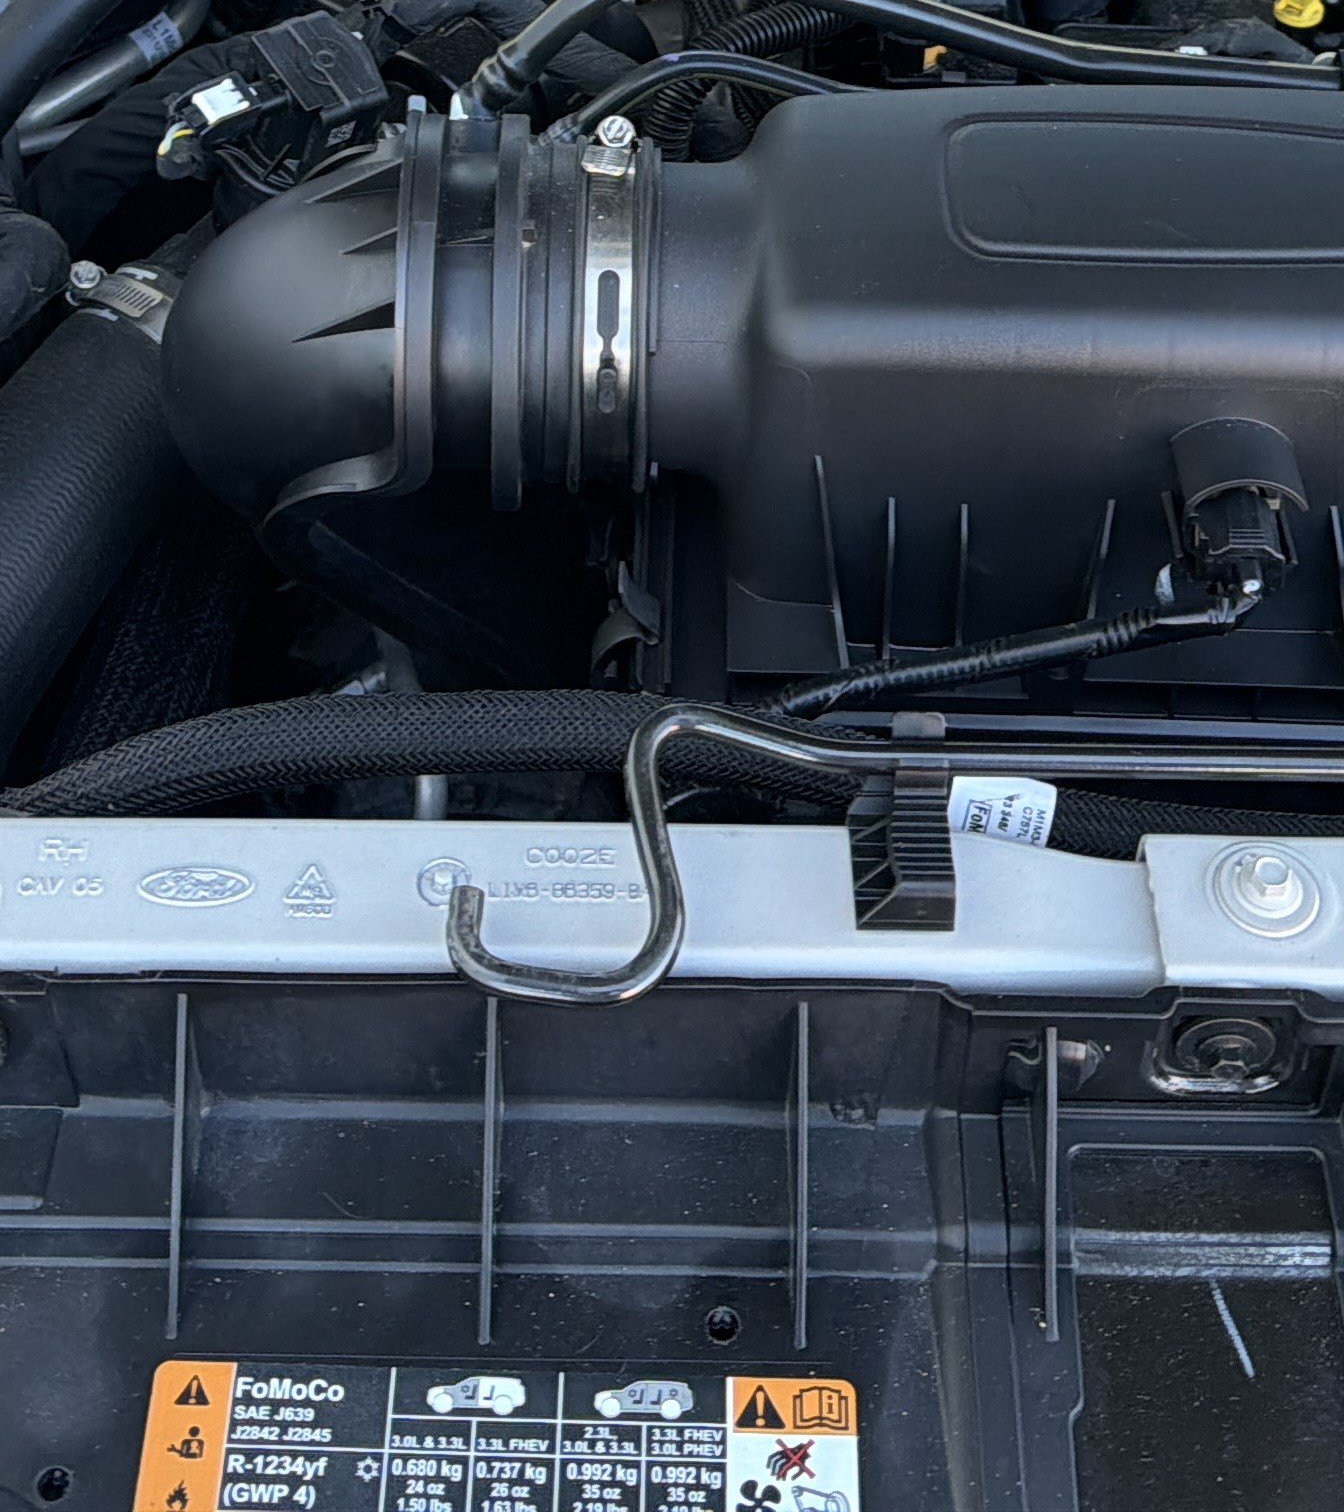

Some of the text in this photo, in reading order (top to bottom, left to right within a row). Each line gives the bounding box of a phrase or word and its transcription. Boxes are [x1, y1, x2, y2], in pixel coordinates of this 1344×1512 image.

[235, 1376, 345, 1402] FoMoCo
[233, 1405, 315, 1422] SAE J639
[230, 1425, 333, 1443] J2842 J2845
[391, 1434, 467, 1450] 3.0L & 3.3L
[651, 1428, 723, 1442] 3.3L FHEV
[477, 1437, 550, 1452] 3.3L FHEV
[562, 1441, 640, 1455] 3.0L & 3.3L
[651, 1442, 723, 1457] 3.0L PHEV
[226, 1454, 329, 1481] R-1234yf
[391, 1458, 463, 1482] 0.680 kg
[476, 1461, 547, 1485] 0.737 kg
[566, 1462, 638, 1486] 0.992 kg
[650, 1465, 723, 1489] 0.992 kg
[223, 1482, 316, 1510] (GWP 4)
[405, 1479, 446, 1496] 24 oz
[511, 1485, 531, 1498] oz
[581, 1484, 623, 1500] 35 oz
[667, 1486, 707, 1503] 35 oz
[396, 1497, 453, 1512] 1.50 lbs
[514, 1500, 538, 1512] lbs
